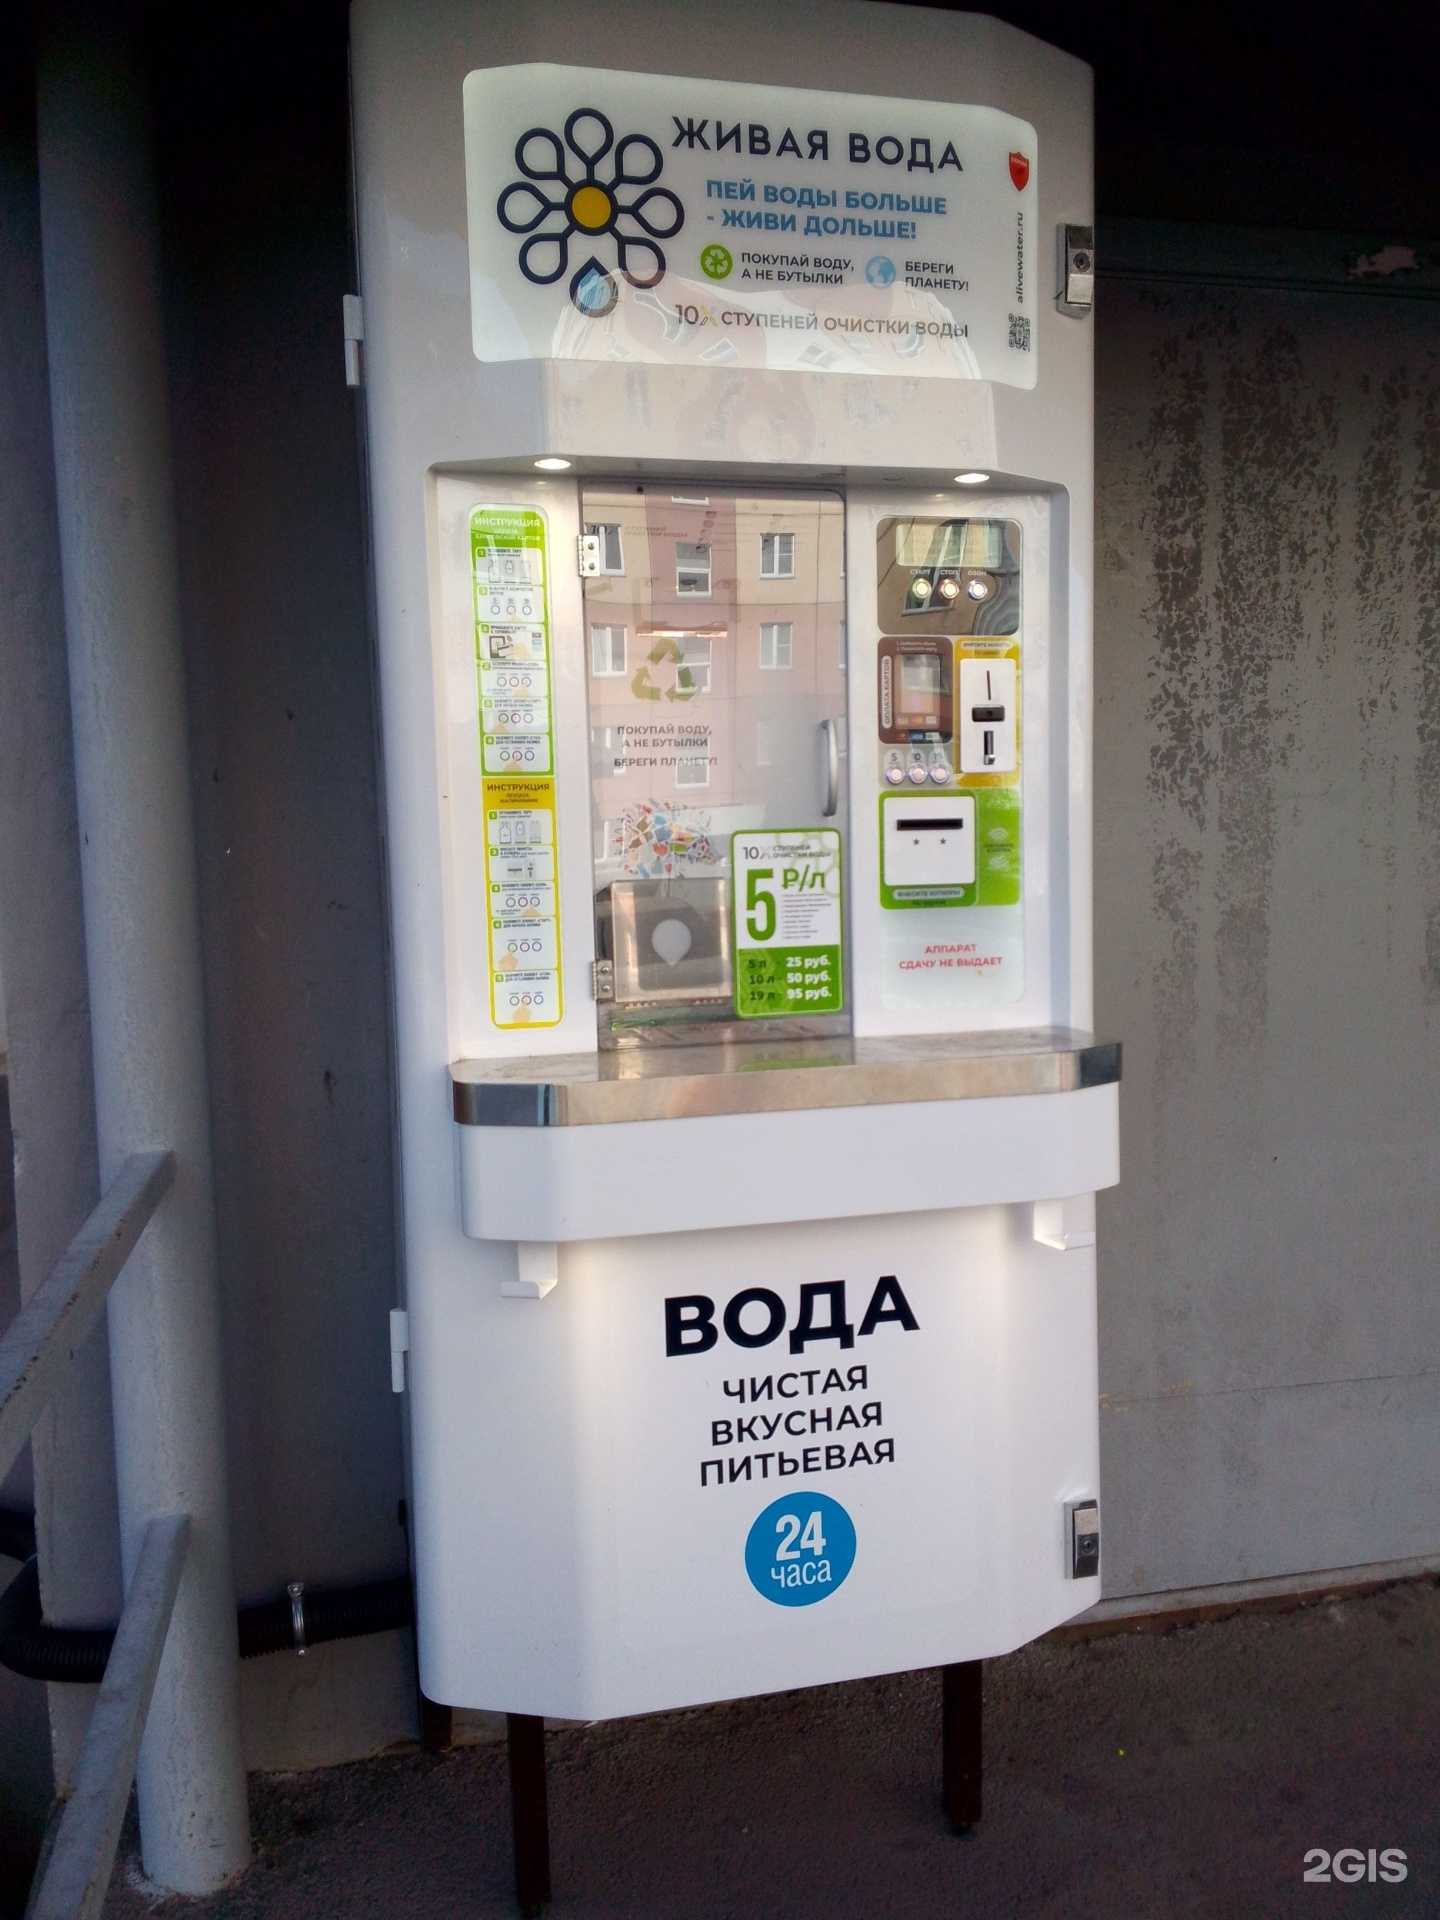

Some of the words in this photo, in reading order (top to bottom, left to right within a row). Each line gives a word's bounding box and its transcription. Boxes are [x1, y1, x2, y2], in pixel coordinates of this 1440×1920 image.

[672, 116, 828, 160] ЖИВАЯ
[849, 133, 963, 173] ВОДА
[706, 178, 756, 200] ПЕЙ
[763, 185, 837, 208] ВОДЫ
[845, 192, 947, 215] БОЛЬШЕ
[721, 209, 797, 232] ЖИВИ
[804, 215, 917, 239] ДОЛЬШЕ!
[741, 251, 811, 268] ПОКУПАЙ
[813, 258, 855, 272] ВОДУ,
[905, 260, 955, 275] БЕРЕГИ
[1016, 211, 1024, 304] alivewater.ru
[741, 270, 751, 280] А
[755, 271, 774, 281] НЕ
[777, 272, 844, 285] БУТЫЛКИ
[904, 276, 969, 291] ПЛАНЕТУ!
[720, 311, 818, 331] СТУПЕНЕЙ
[823, 317, 910, 335] ОЧИСТКИ
[914, 322, 969, 338] ВОДЫ
[617, 724, 674, 735] ПОКУПАЙ
[678, 725, 712, 735] ВОДУ,
[624, 739, 631, 747] А
[634, 739, 649, 747] НЕ
[652, 738, 708, 748] БУТЫЛКИ
[613, 758, 657, 767] БЕРЕГИ
[487, 783, 550, 792] ИНСТРУКЦИЯ
[746, 868, 776, 941] 5
[924, 944, 977, 954] АППАРАТ
[785, 956, 802, 967] 25
[804, 954, 831, 969] руб.
[899, 959, 937, 970] СДАЧУ
[940, 959, 954, 967] НЕ
[957, 957, 1003, 967] ВЫДАЕТ
[750, 974, 764, 984] 10
[787, 972, 803, 983] 50
[805, 970, 832, 985] руб.
[750, 990, 764, 1000] 19
[787, 988, 803, 999] 95
[805, 986, 832, 1000] руб.
[664, 1275, 920, 1357] ВОДА
[722, 1365, 868, 1404] ЧИСТАЯ
[711, 1401, 883, 1446] ВКУСНАЯ
[700, 1438, 896, 1487] ПИТЬЕВАЯ
[775, 1511, 827, 1562] 24
[770, 1559, 832, 1588] часа
